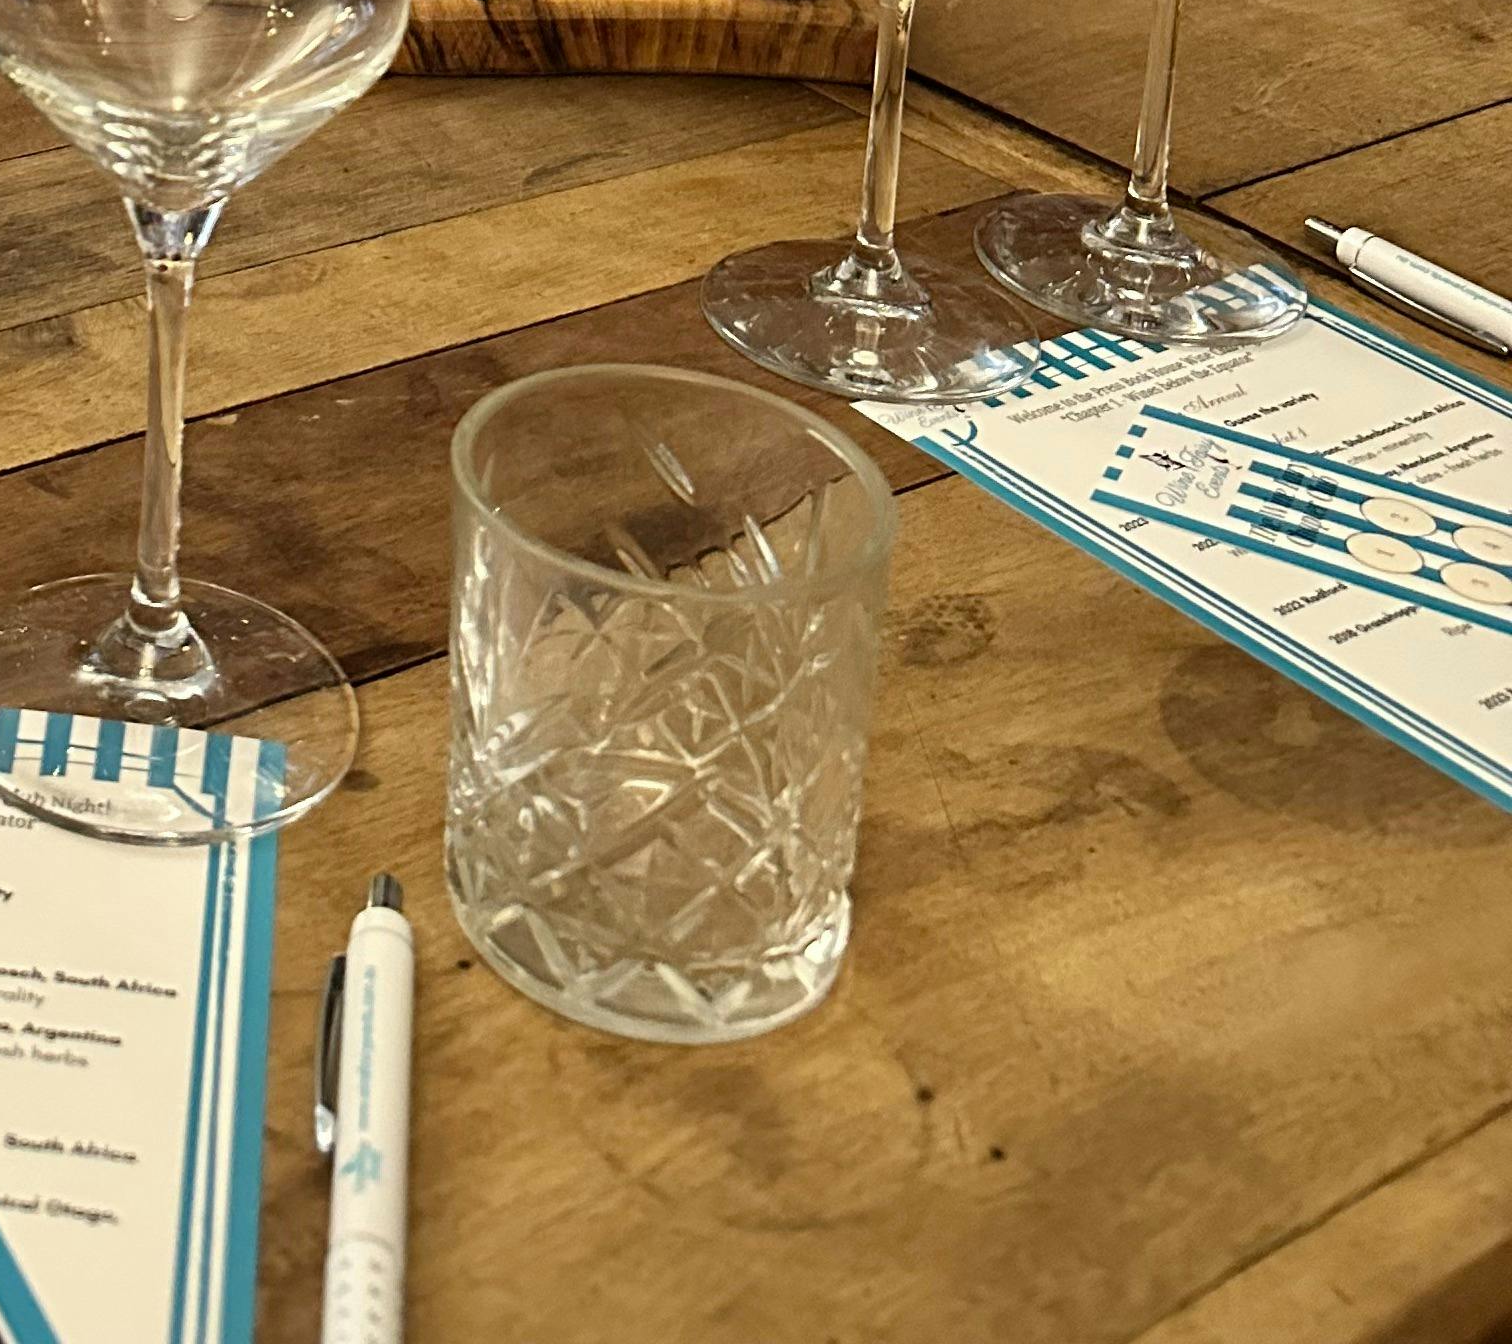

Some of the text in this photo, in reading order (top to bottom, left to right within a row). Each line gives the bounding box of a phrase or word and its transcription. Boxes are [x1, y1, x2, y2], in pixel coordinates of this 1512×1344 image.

[50, 796, 113, 818] Night!
[52, 969, 111, 991] South
[116, 977, 179, 999] Africa
[20, 1021, 124, 1048] Argentina
[3, 1131, 65, 1154] South
[71, 1140, 140, 1165] Africa
